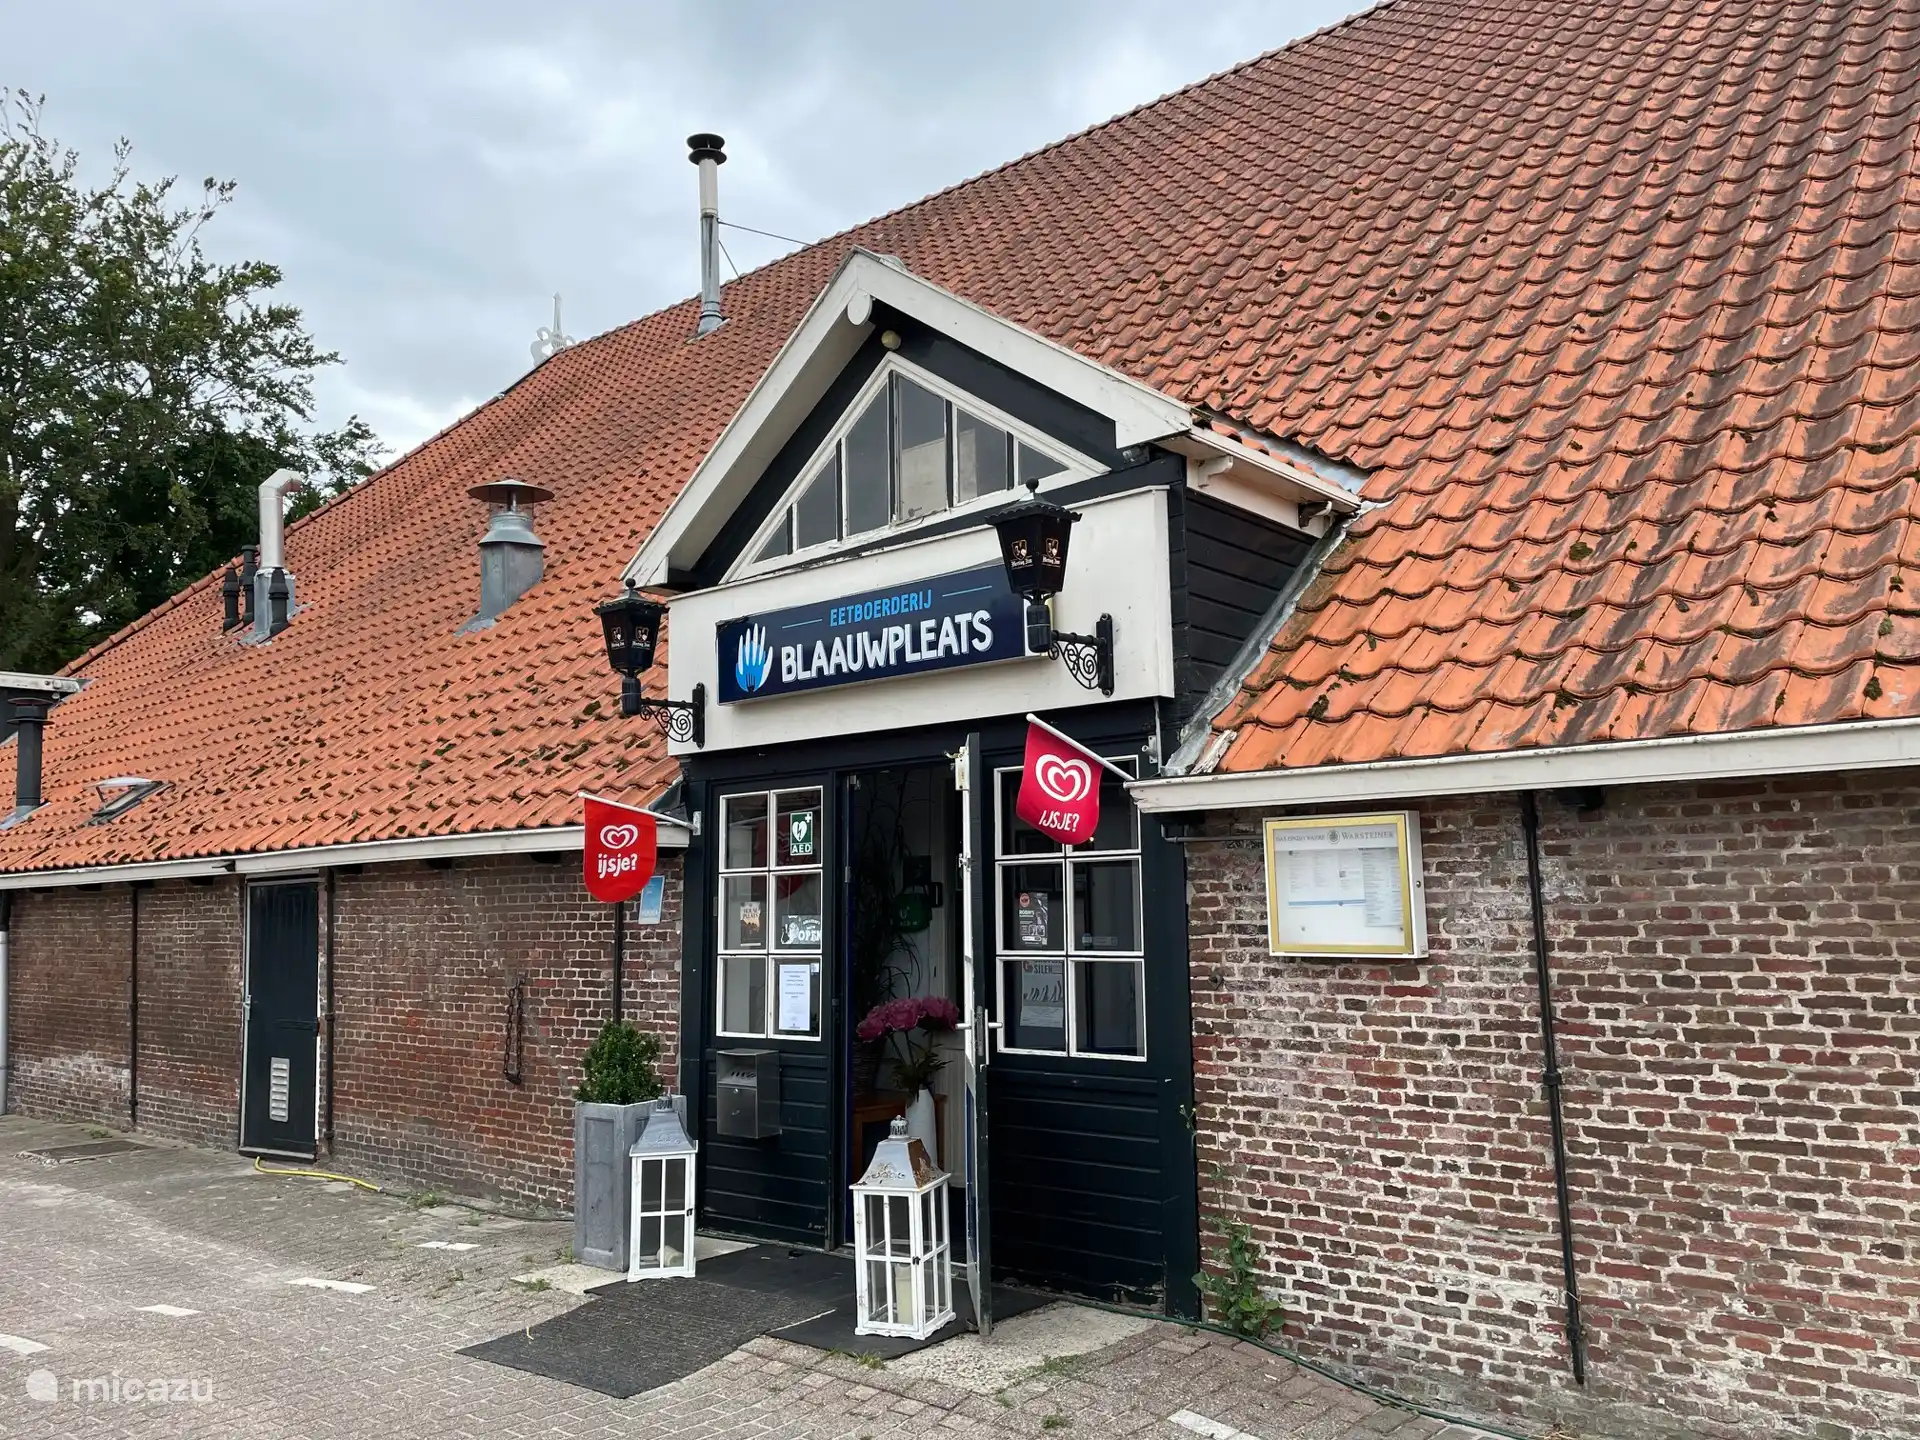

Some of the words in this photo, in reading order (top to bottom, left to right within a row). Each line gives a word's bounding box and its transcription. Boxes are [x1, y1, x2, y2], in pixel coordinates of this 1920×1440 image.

[830, 589, 932, 627] EETBOERDERIJ
[781, 610, 994, 684] BLAAUWPLEATS
[1039, 810, 1080, 832] IJSJE?
[1341, 831, 1393, 841] WARSTEINER
[792, 844, 811, 853] AED
[598, 853, 638, 879] ijsje?
